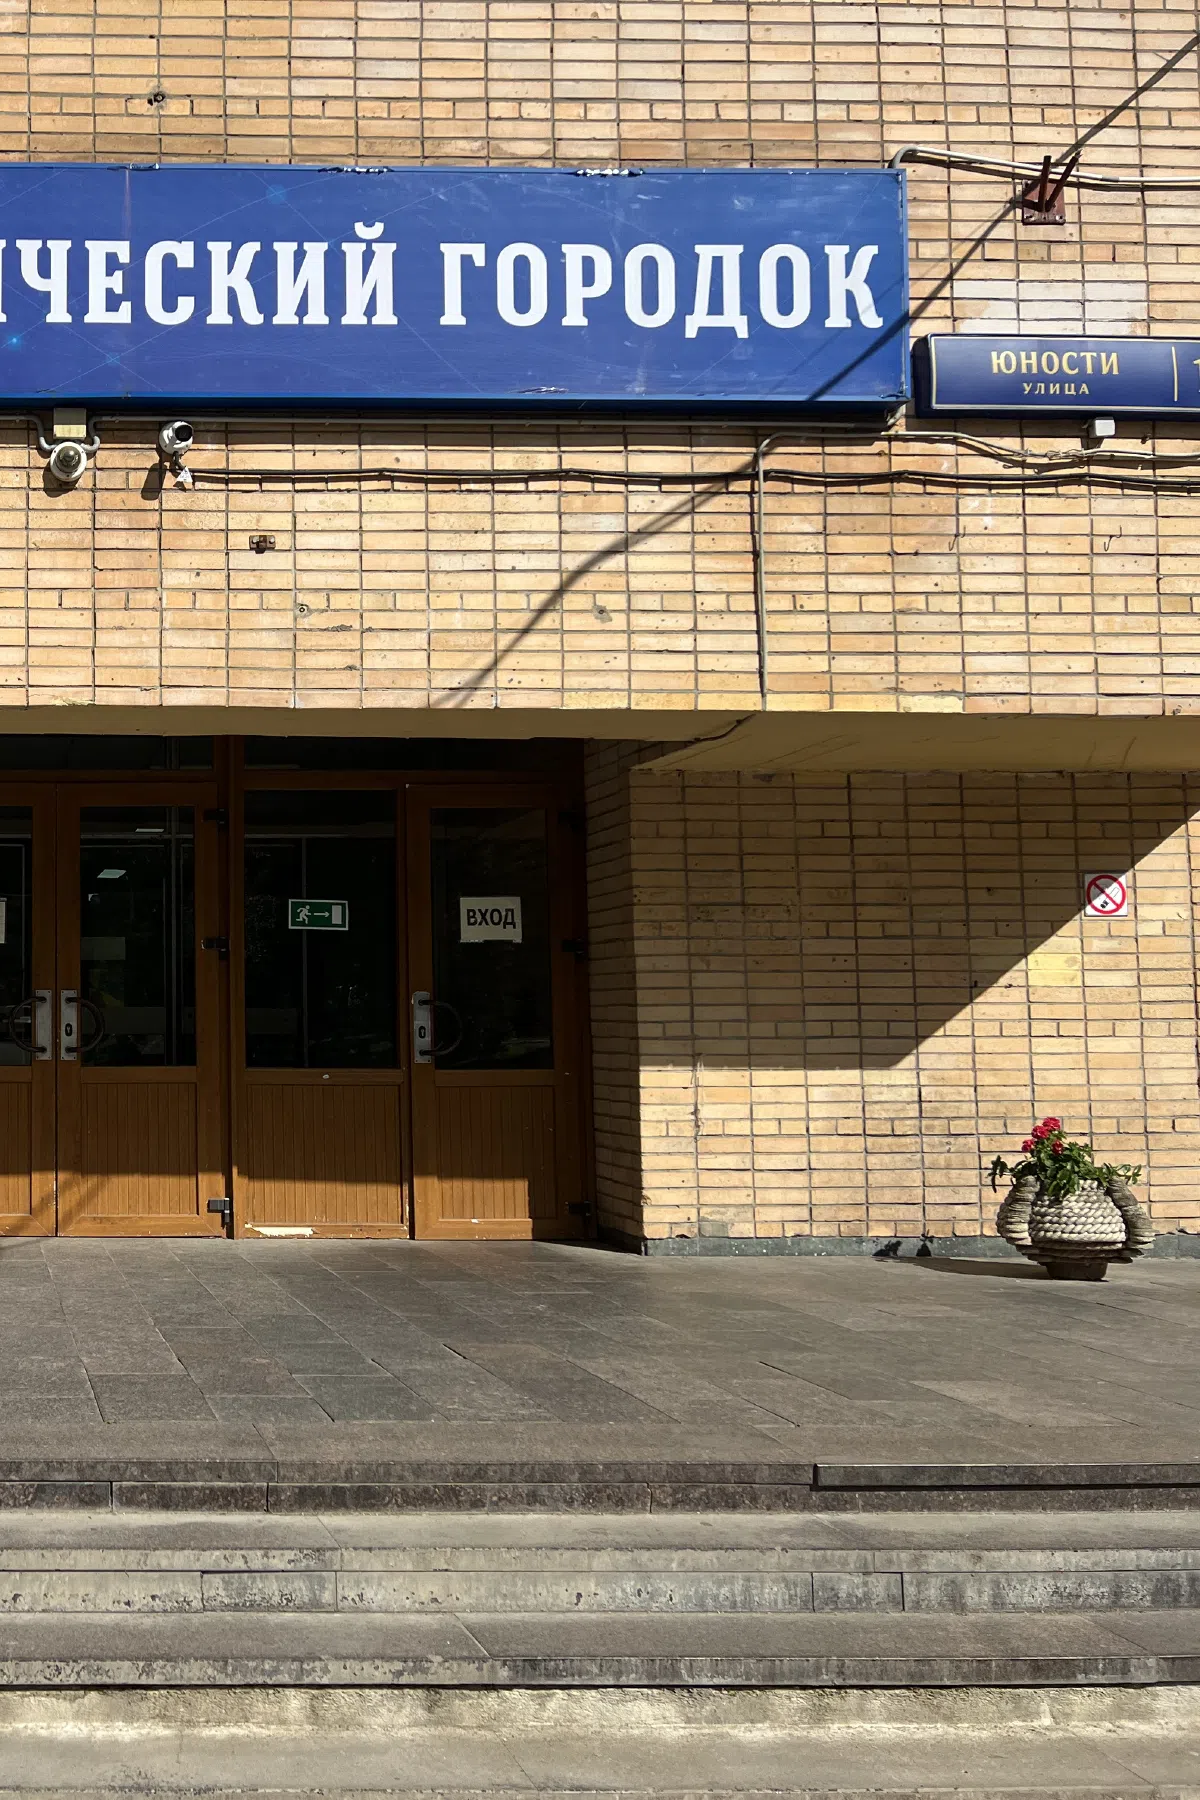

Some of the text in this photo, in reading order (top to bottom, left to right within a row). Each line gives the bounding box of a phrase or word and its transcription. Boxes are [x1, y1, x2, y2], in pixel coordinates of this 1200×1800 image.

[439, 242, 884, 339] ГОРОДОК
[990, 350, 1120, 375] ЮНОСТИ
[1022, 382, 1090, 396] УЛИЦА
[466, 908, 517, 929] ВХОД
